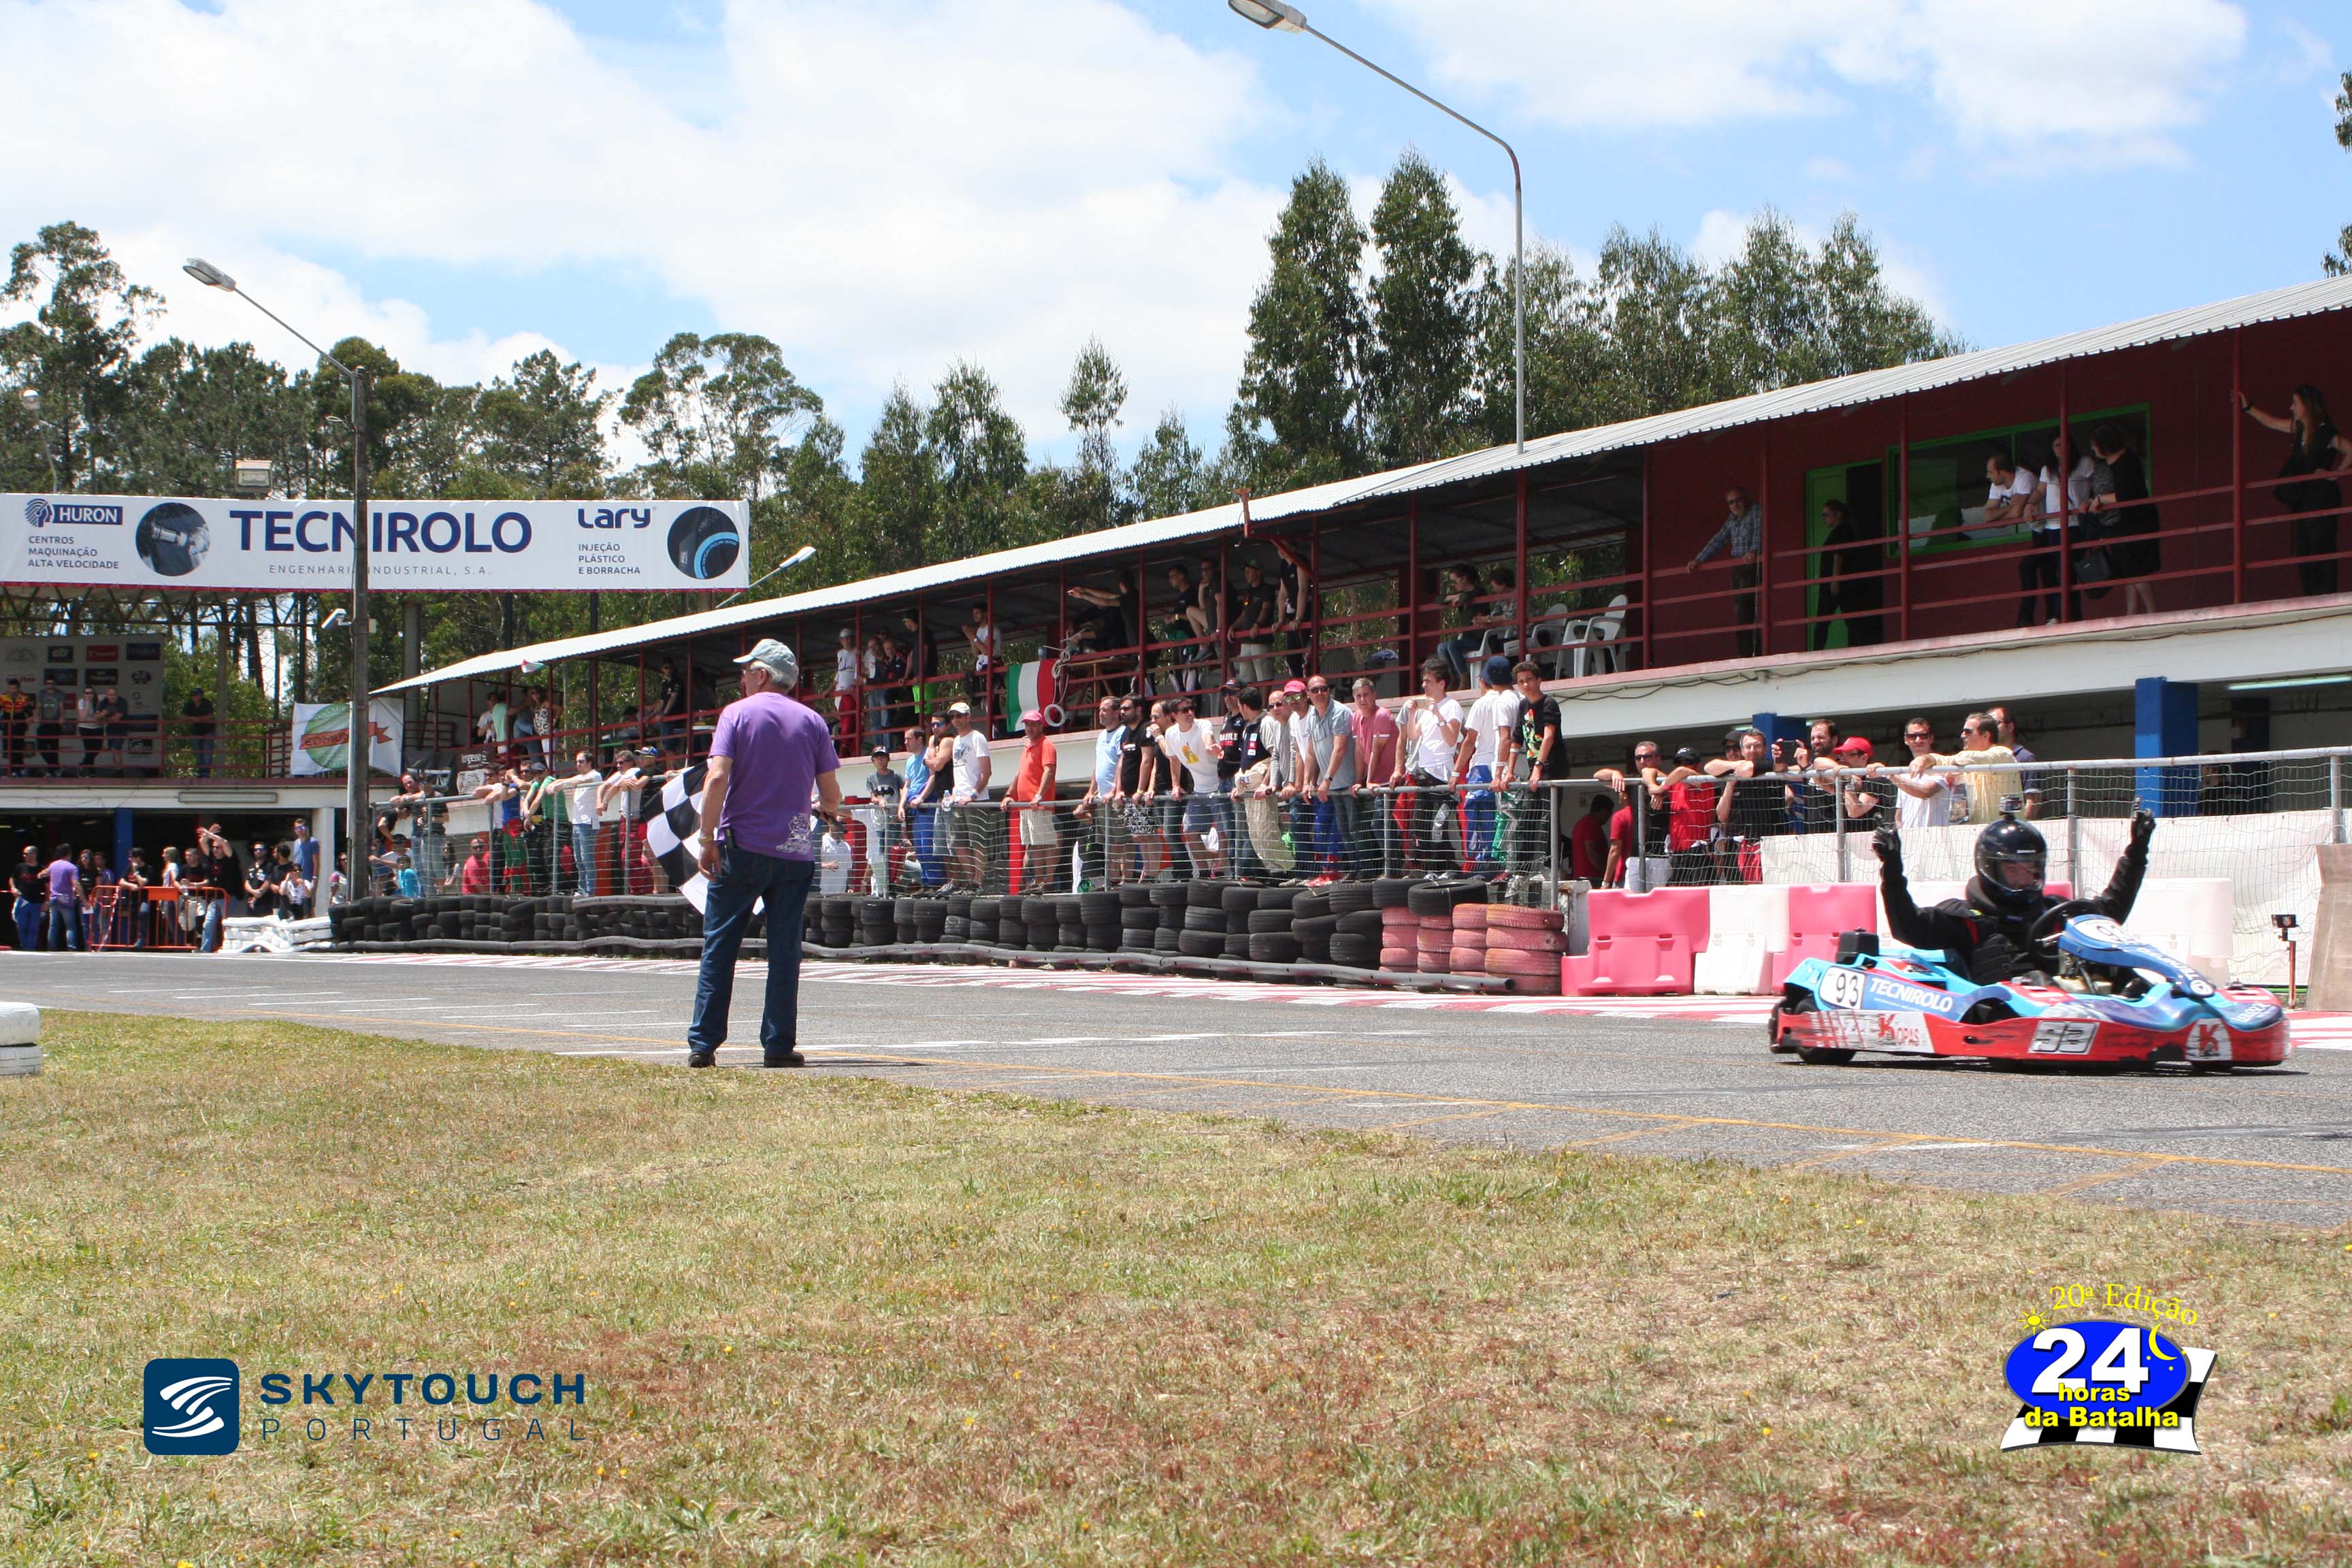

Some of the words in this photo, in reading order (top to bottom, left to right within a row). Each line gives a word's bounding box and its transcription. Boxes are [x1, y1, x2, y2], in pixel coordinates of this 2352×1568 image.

[59, 507, 118, 523] HURON
[229, 510, 532, 553] TECNIROLO
[29, 536, 74, 544] CENTROS
[28, 546, 97, 557] MAQUINAÇÃO
[578, 542, 620, 553] INJEÇÃO
[578, 553, 625, 563] PLÁSTICO
[28, 559, 53, 568] ALTA
[56, 560, 119, 570] VELOCIDADE
[269, 565, 355, 574] ENGENHARI
[464, 566, 491, 575] S.A.
[578, 566, 584, 574] E
[586, 566, 640, 575] BORRACHA
[1836, 973, 1859, 1007] 93
[1869, 977, 1953, 1013] TECNIROLO
